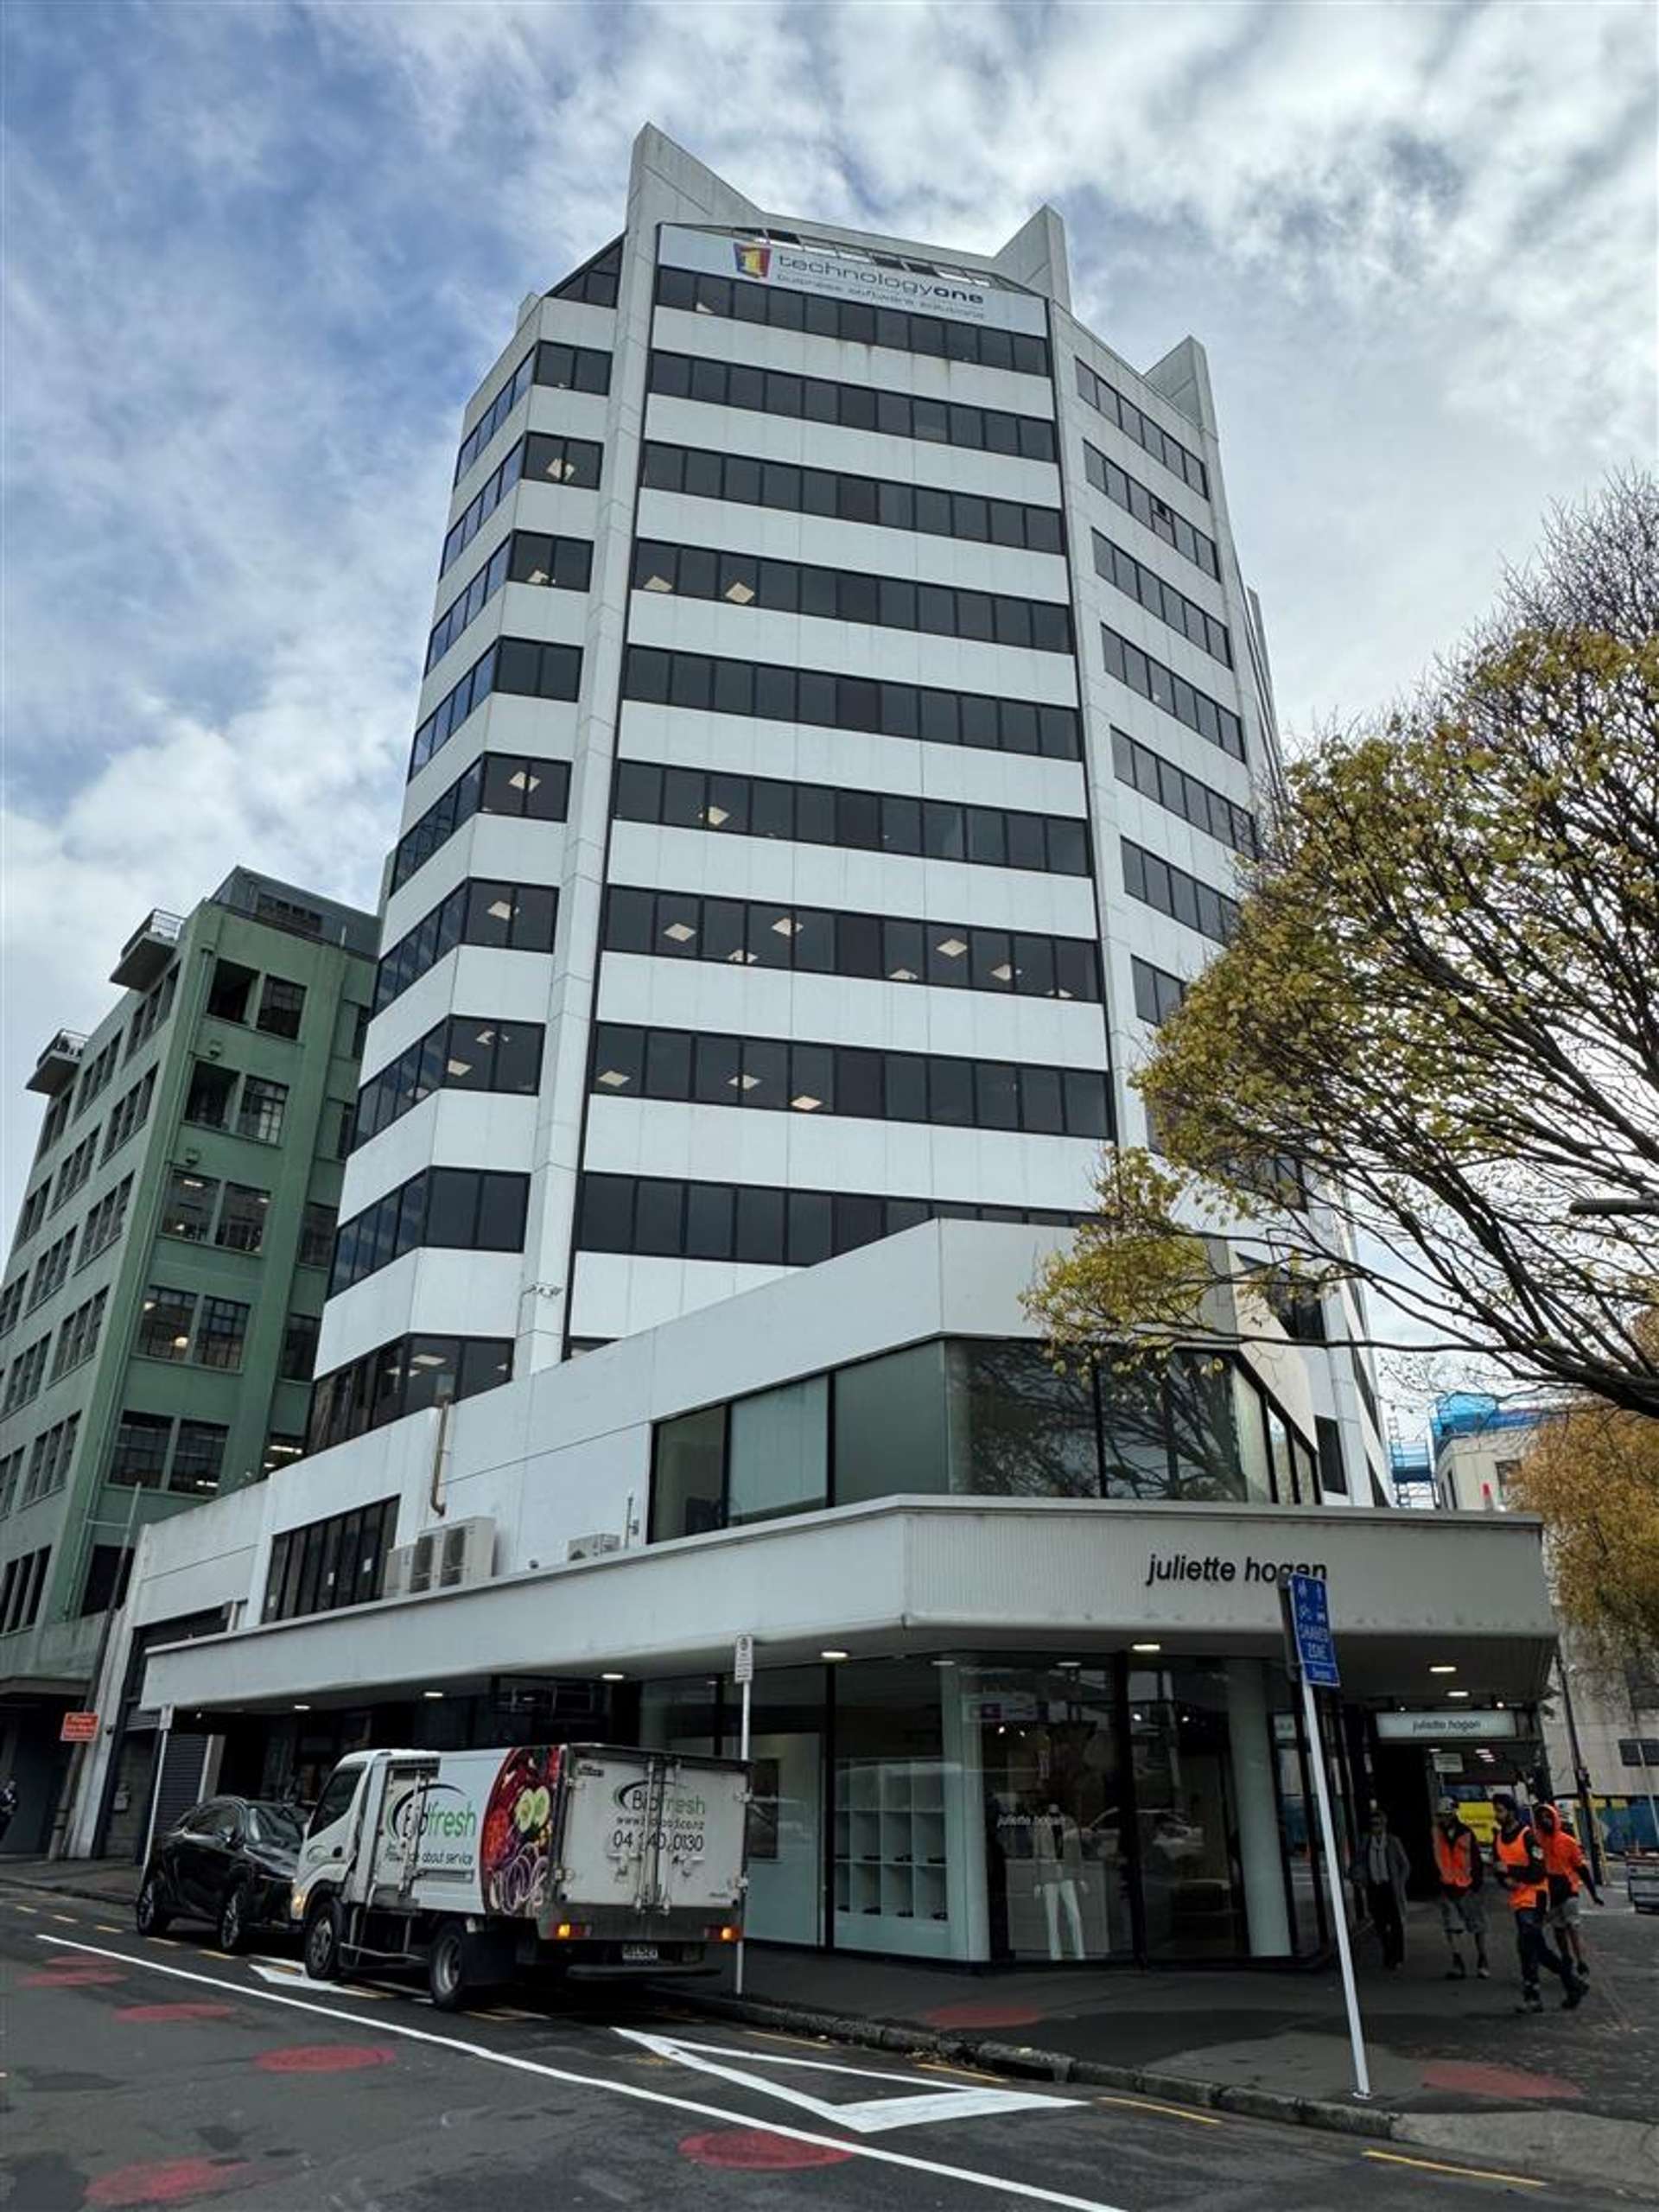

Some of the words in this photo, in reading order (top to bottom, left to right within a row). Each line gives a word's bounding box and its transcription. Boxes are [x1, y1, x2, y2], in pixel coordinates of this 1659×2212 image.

[779, 255, 983, 304] technologyone
[1145, 1554, 1235, 1586] juliette
[613, 1829, 632, 1849] 04
